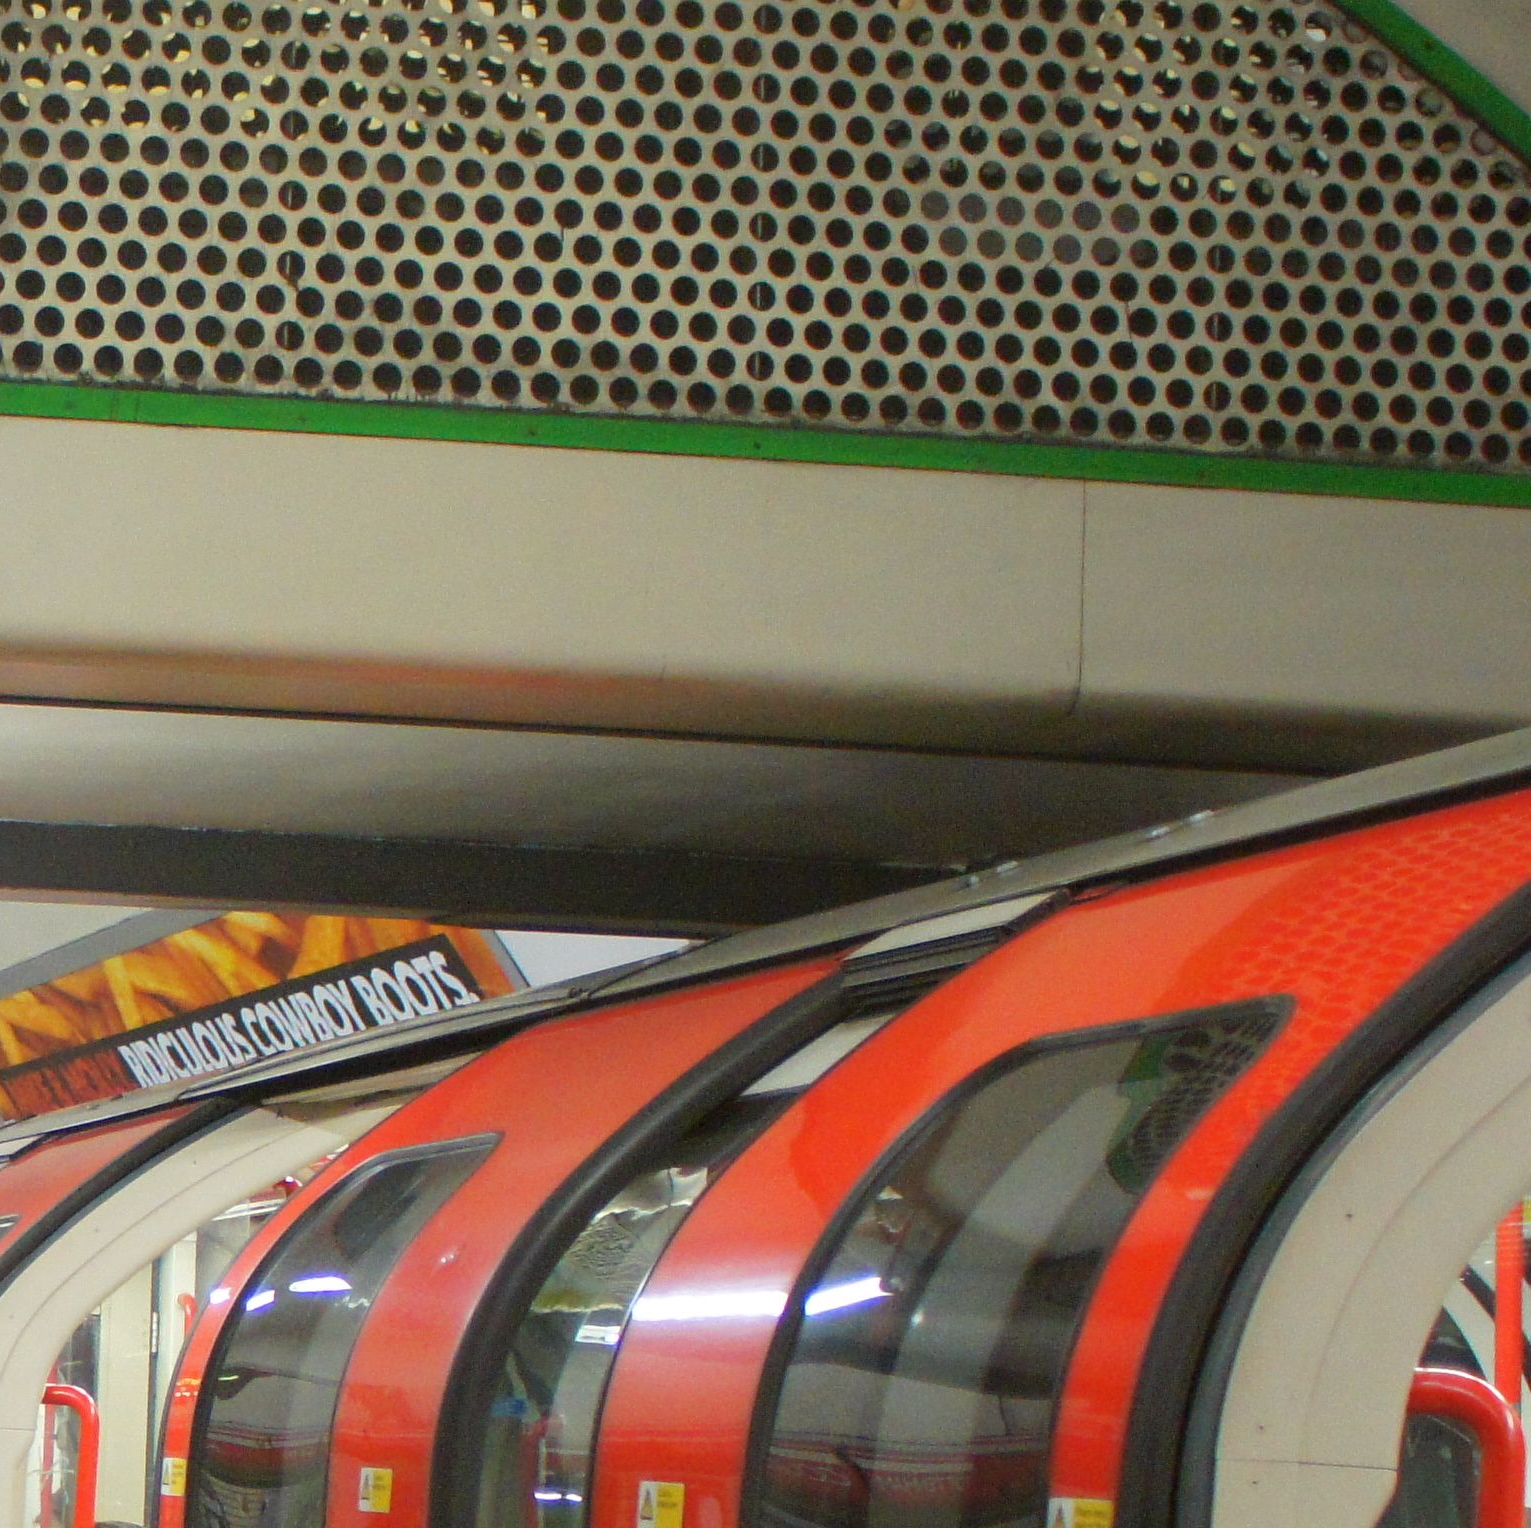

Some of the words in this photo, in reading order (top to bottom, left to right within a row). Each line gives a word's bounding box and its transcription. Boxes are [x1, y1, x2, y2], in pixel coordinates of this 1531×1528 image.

[117, 1011, 254, 1089] RIDICULOUS
[240, 979, 367, 1057] COWBOY
[349, 949, 481, 1027] BOOTS.
